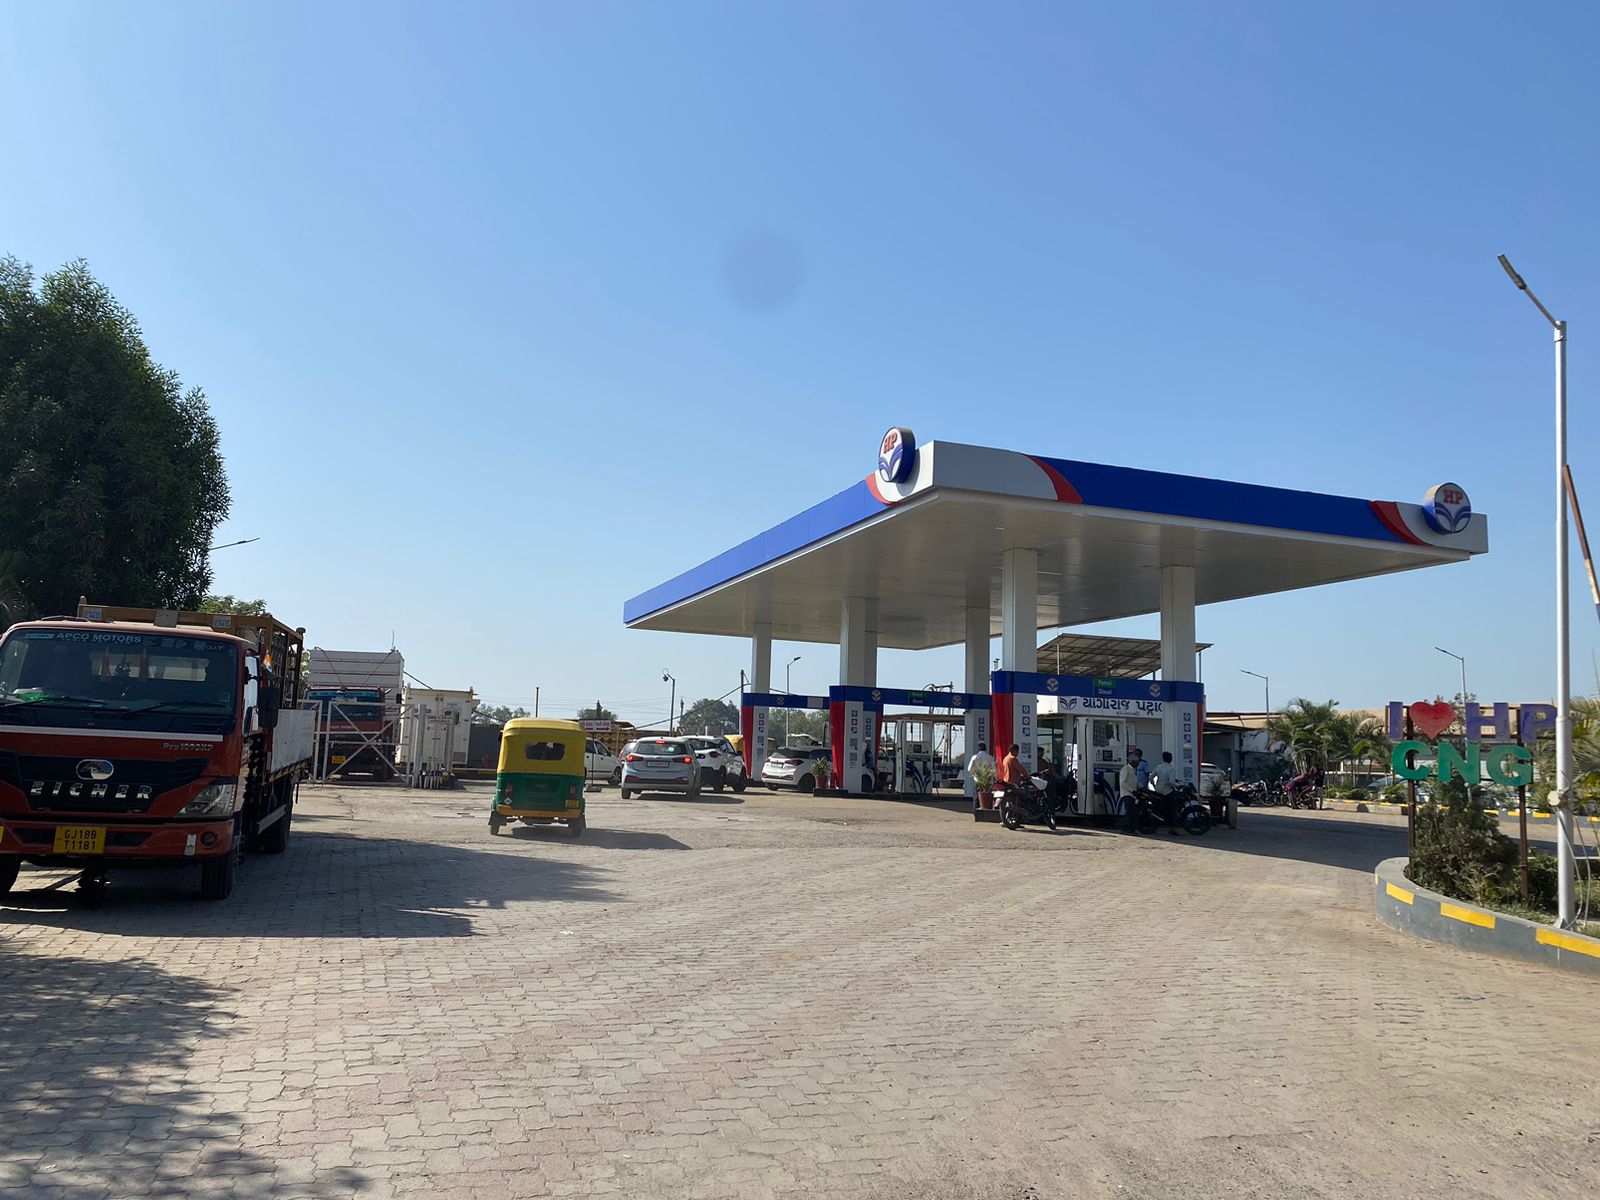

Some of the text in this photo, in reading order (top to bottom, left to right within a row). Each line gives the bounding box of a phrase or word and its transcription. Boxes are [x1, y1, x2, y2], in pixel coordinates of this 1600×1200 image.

[883, 432, 898, 454] HP
[1443, 489, 1464, 505] HP
[56, 632, 89, 641] APCO
[92, 634, 142, 644] MOTORS
[1389, 701, 1558, 745] I HP
[1392, 740, 1533, 787] CNG
[30, 781, 153, 799] EICHER
[64, 829, 97, 839] GJ18B
[64, 840, 96, 850] T1181
